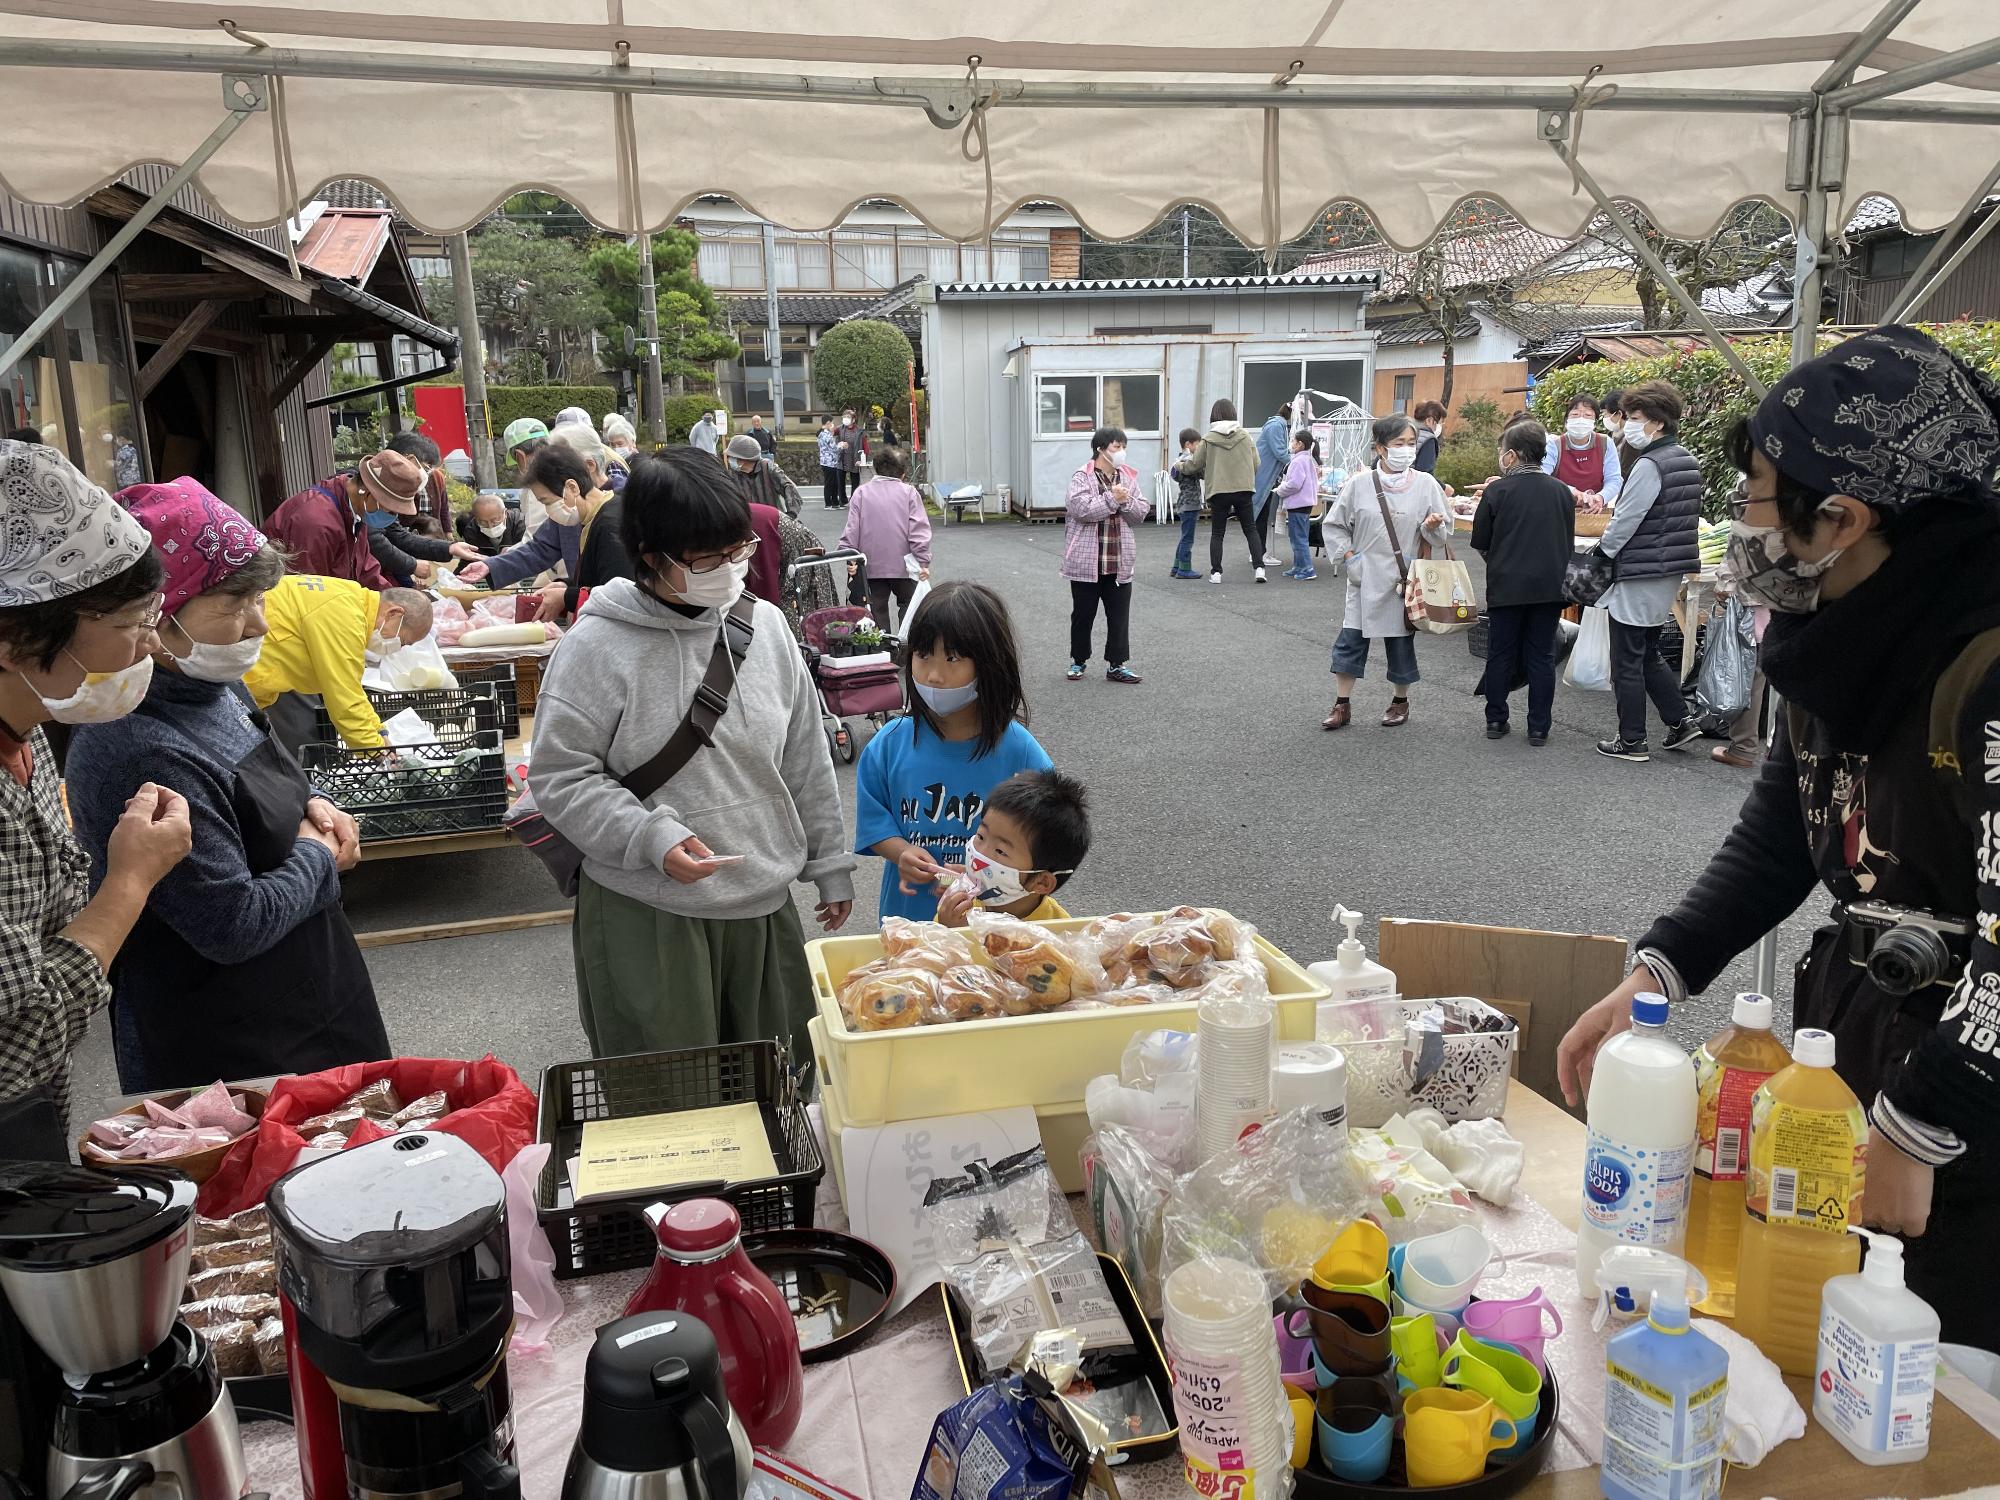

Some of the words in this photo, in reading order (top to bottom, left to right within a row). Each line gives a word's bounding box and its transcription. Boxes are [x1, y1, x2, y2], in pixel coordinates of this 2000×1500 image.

[923, 783, 984, 831] Jap
[1588, 1170, 1621, 1198] SODA
[1836, 1326, 1866, 1356] Alcohol
[1204, 1432, 1240, 1448] PAPER
